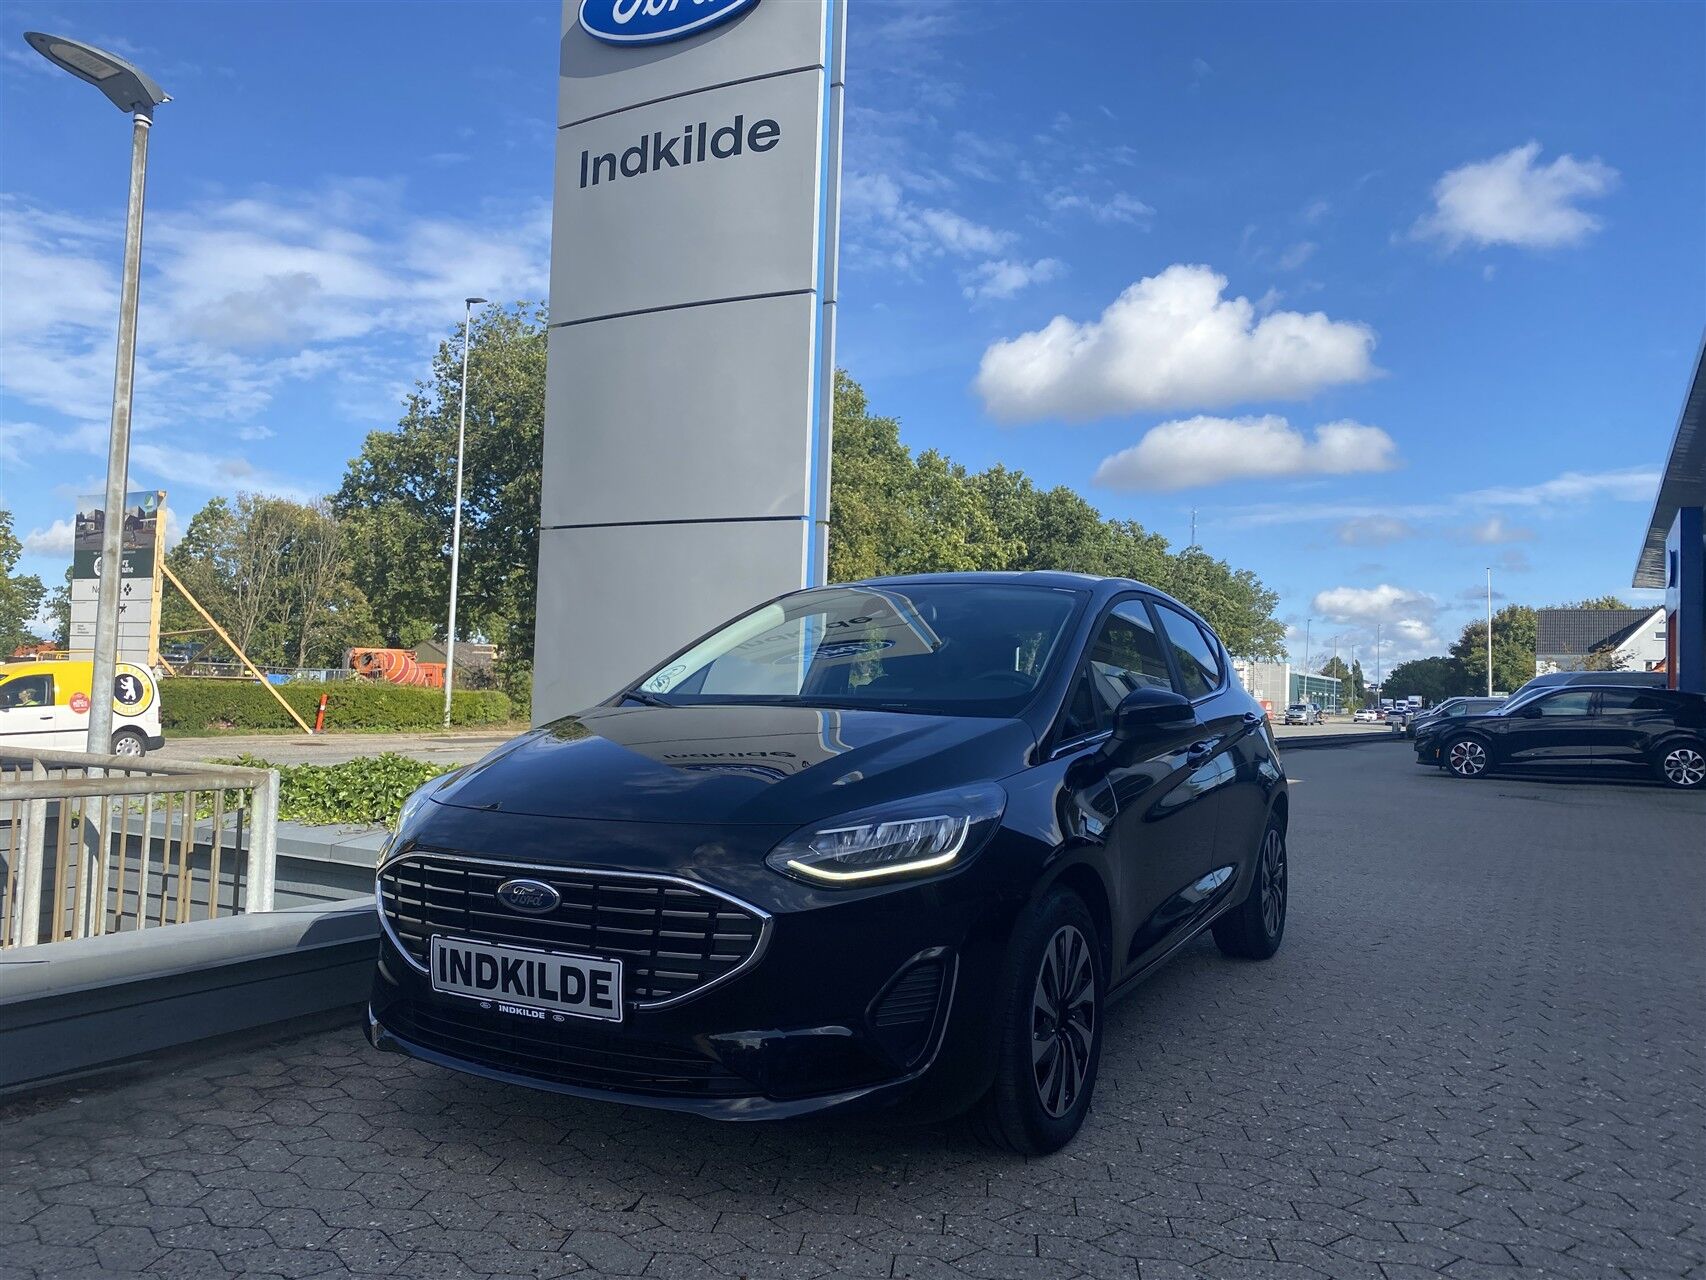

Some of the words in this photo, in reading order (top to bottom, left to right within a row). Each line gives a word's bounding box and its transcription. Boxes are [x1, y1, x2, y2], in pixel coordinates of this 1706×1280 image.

[579, 115, 781, 188] Indkilde
[511, 886, 544, 906] Ford
[439, 947, 613, 1010] INDKILDE
[498, 1004, 546, 1019] INDKILDE
